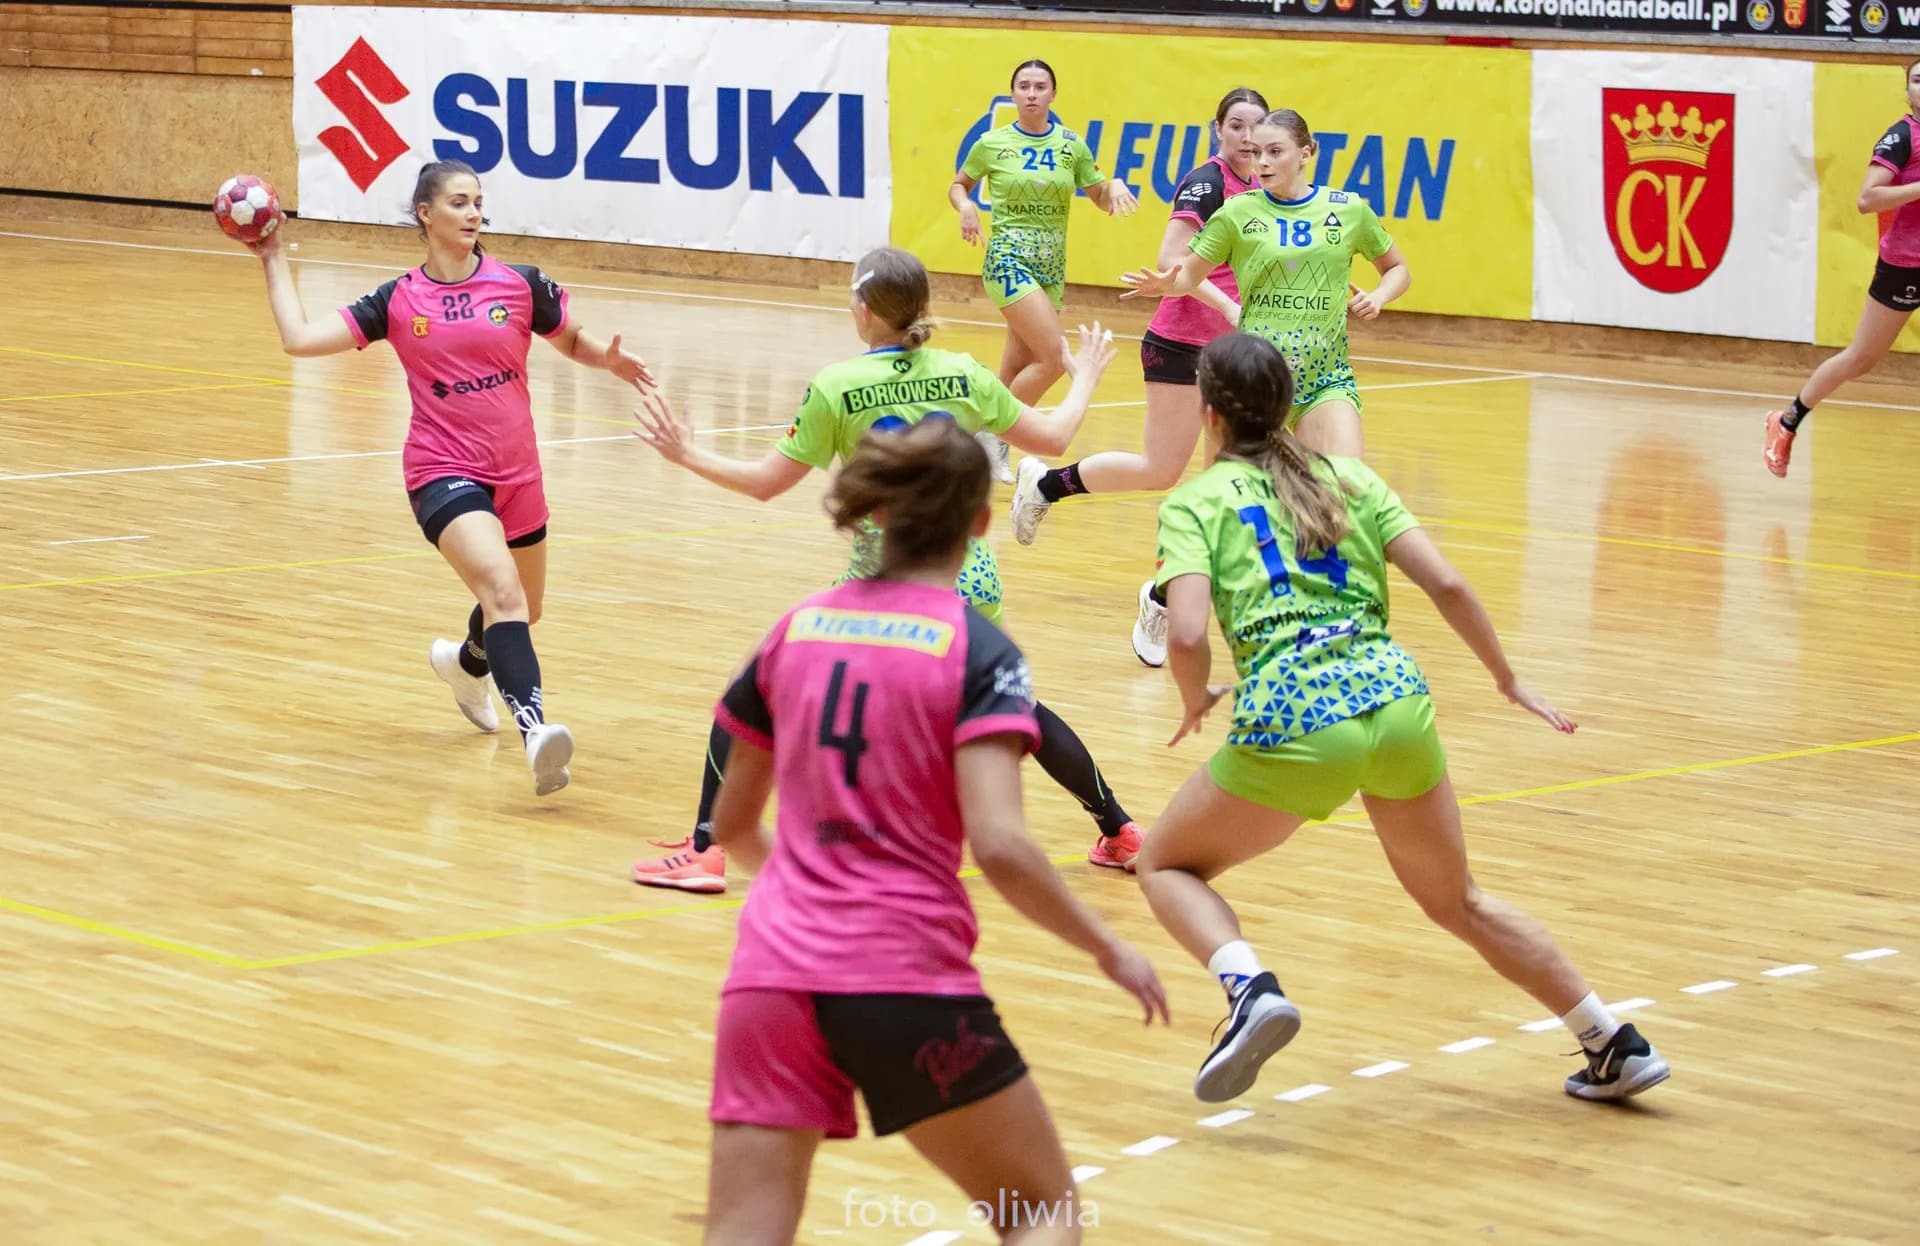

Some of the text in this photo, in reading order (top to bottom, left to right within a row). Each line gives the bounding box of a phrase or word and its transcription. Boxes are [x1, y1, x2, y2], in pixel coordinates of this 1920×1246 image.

[432, 73, 865, 199] SUZUKI
[1021, 147, 1056, 171] 24
[1007, 205, 1066, 216] MARECKIE
[1616, 169, 1706, 269] CK
[1276, 218, 1312, 247] 18
[442, 293, 475, 322] 22
[1250, 294, 1331, 310] MARECKIE
[849, 377, 965, 413] BORKOWSKA
[817, 661, 869, 789] 4
